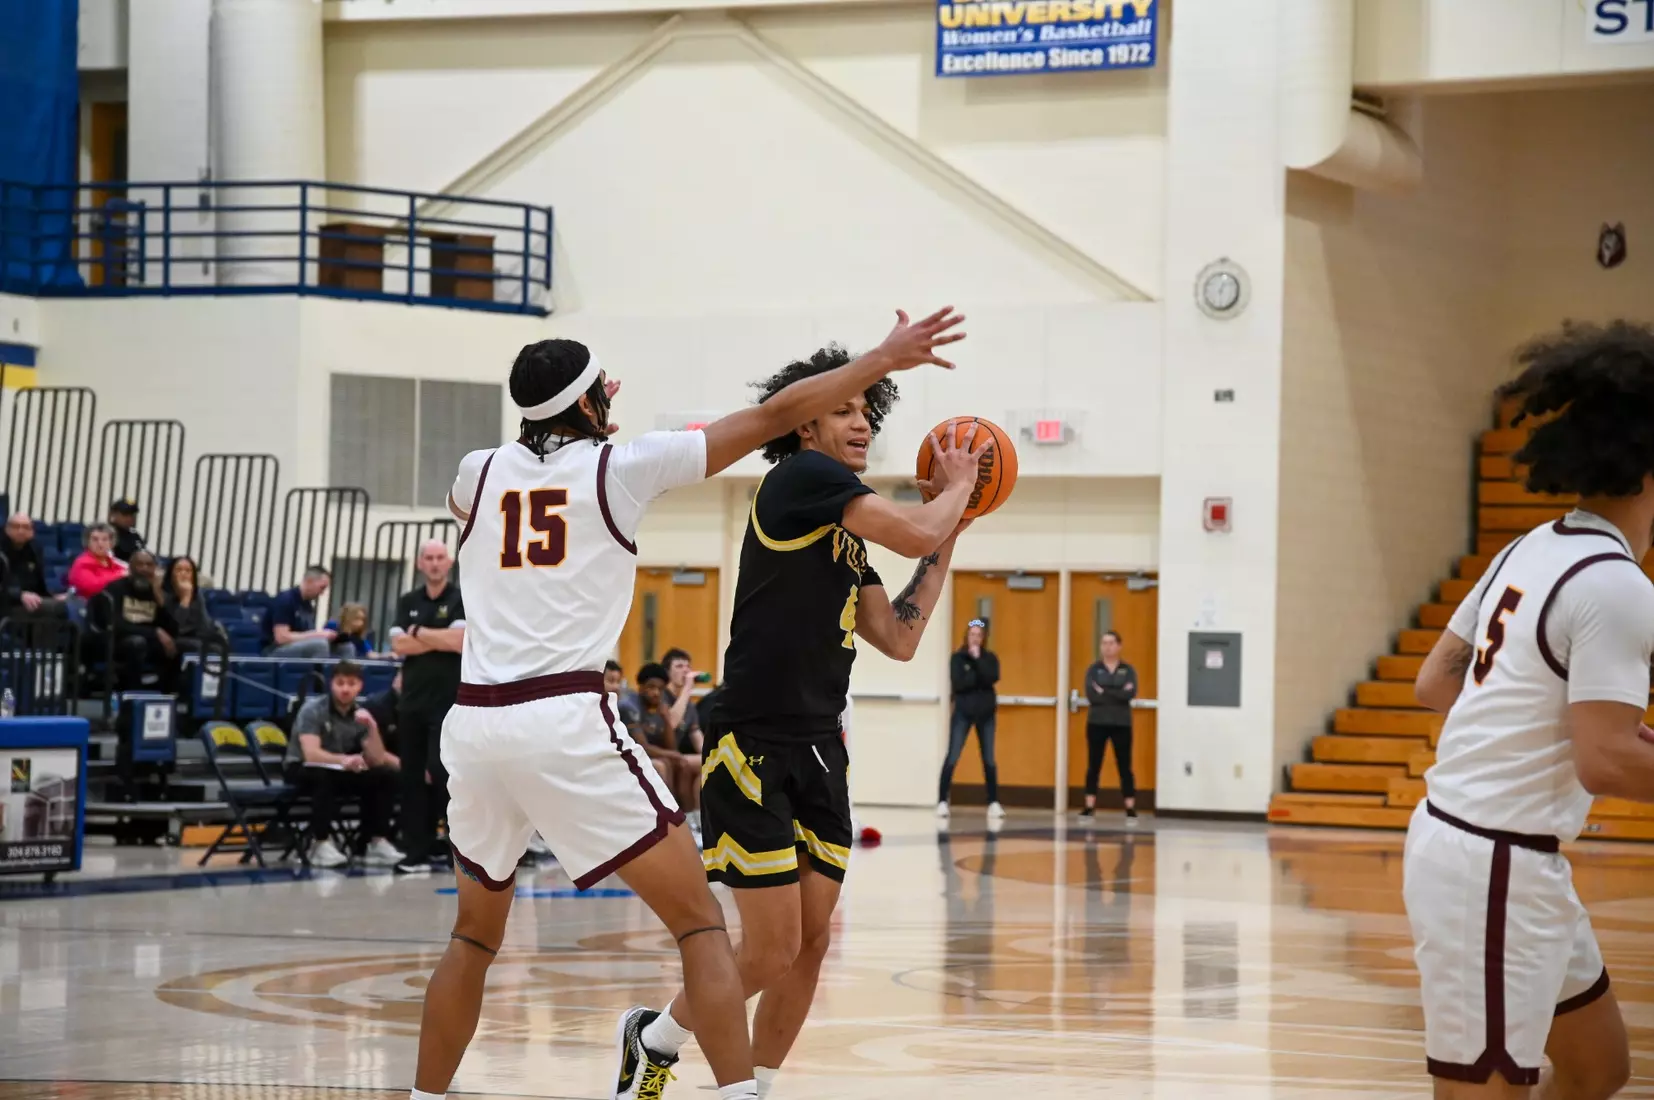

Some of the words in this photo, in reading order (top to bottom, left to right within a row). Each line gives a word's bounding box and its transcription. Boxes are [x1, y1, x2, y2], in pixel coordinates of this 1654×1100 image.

[939, 0, 1152, 28] UNIVERSITY
[943, 26, 1034, 46] Women's
[1039, 19, 1153, 42] Basketball
[942, 51, 1045, 73] Excellence
[1048, 47, 1104, 68] Since
[1107, 43, 1152, 64] 1972
[499, 486, 569, 570] 15
[1473, 584, 1525, 687] 5
